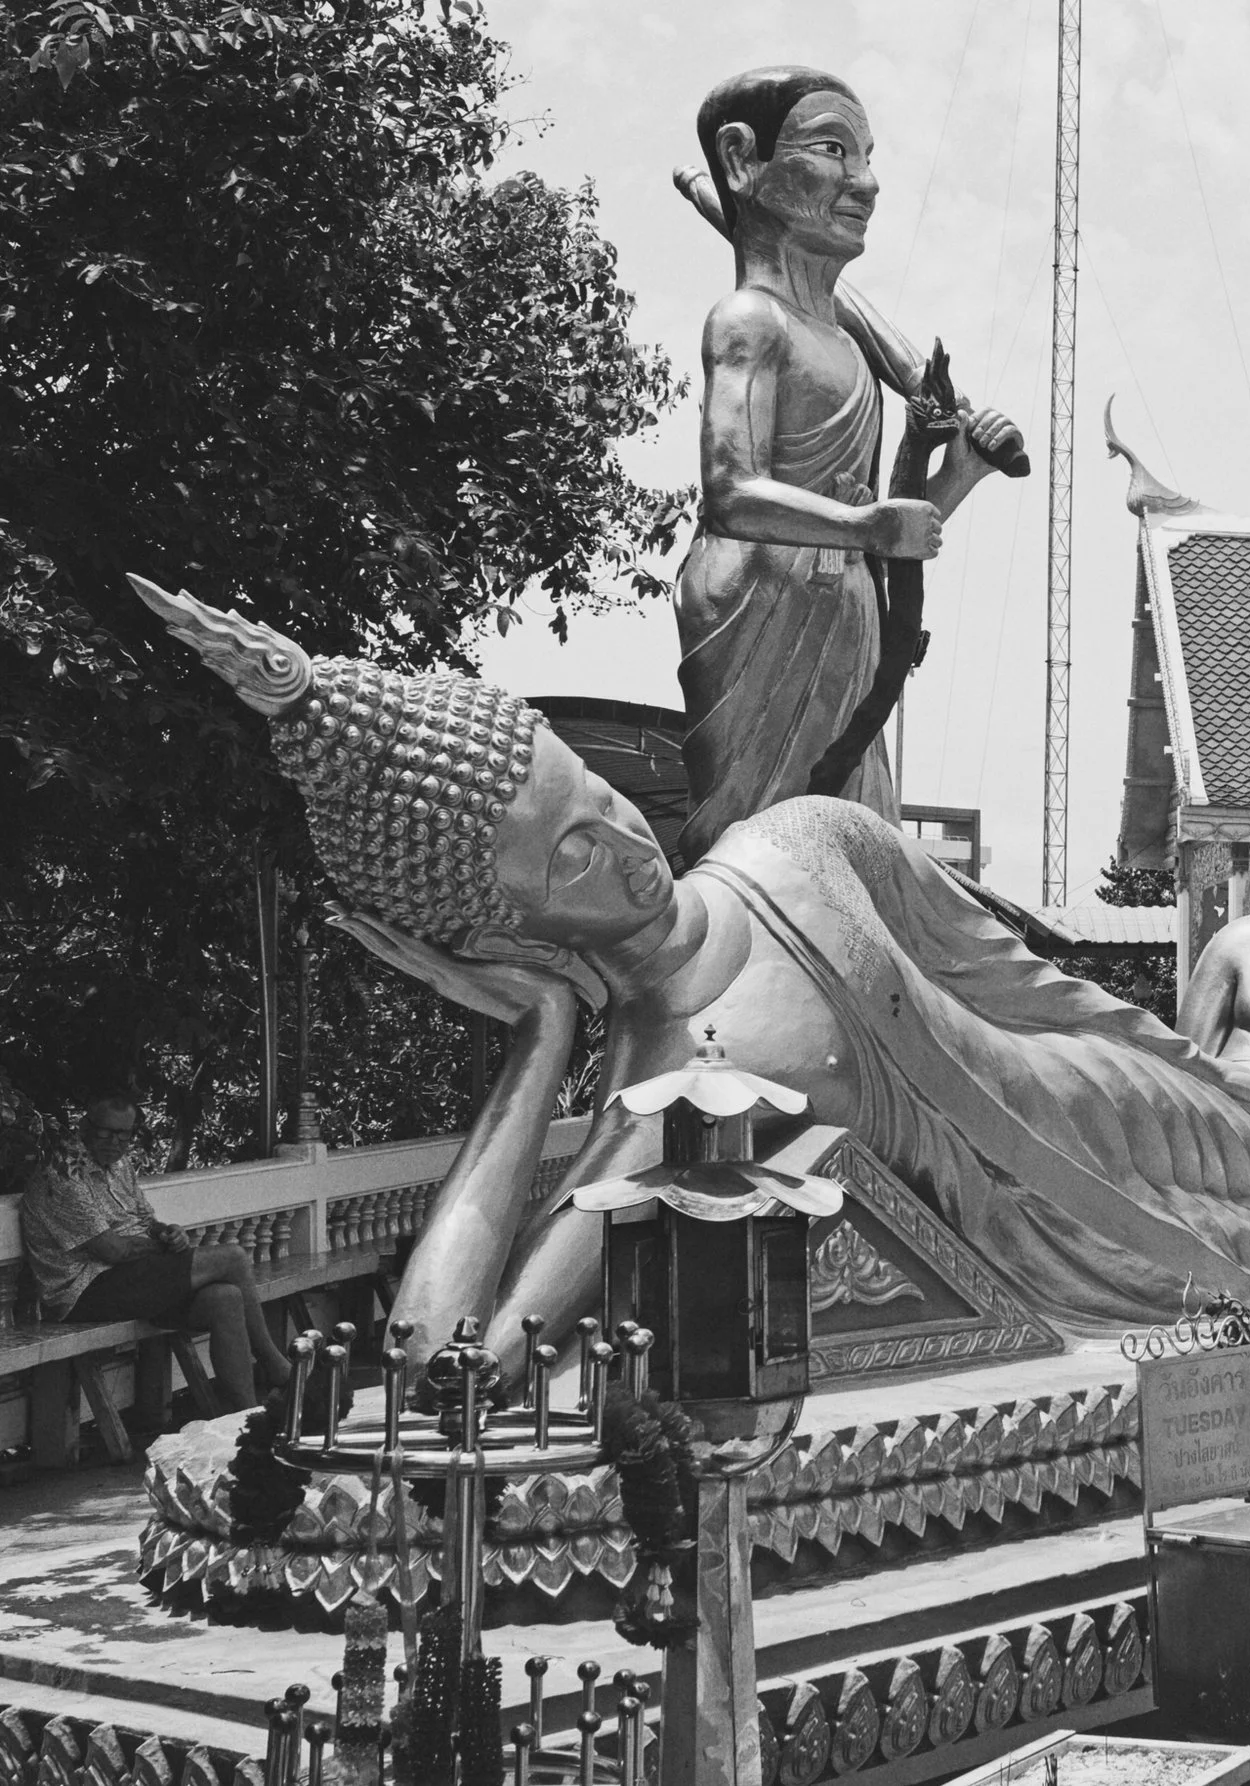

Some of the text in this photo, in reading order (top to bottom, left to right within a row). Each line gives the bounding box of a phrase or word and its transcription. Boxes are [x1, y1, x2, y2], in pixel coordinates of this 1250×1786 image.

[1159, 1367, 1245, 1401] วันอังคาร
[1162, 1404, 1246, 1438] TUESDAY
